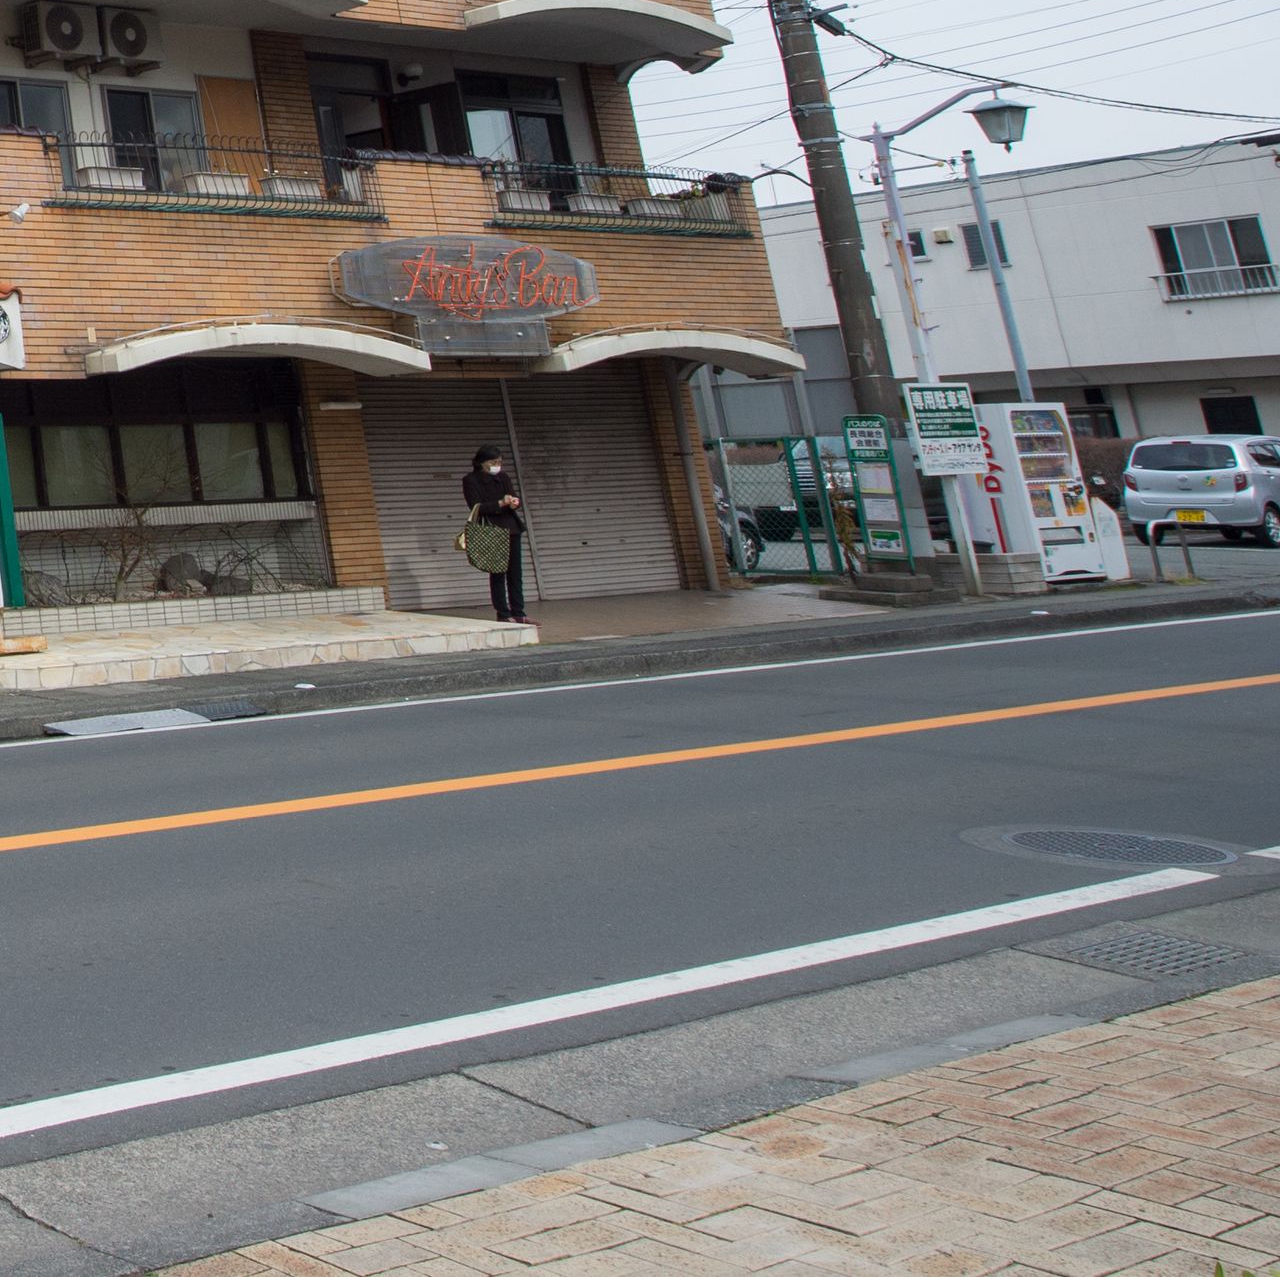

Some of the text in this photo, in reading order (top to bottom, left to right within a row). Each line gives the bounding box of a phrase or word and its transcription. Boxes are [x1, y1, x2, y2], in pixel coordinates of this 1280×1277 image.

[503, 244, 596, 308] Bar
[910, 390, 971, 410] 専用駐車場
